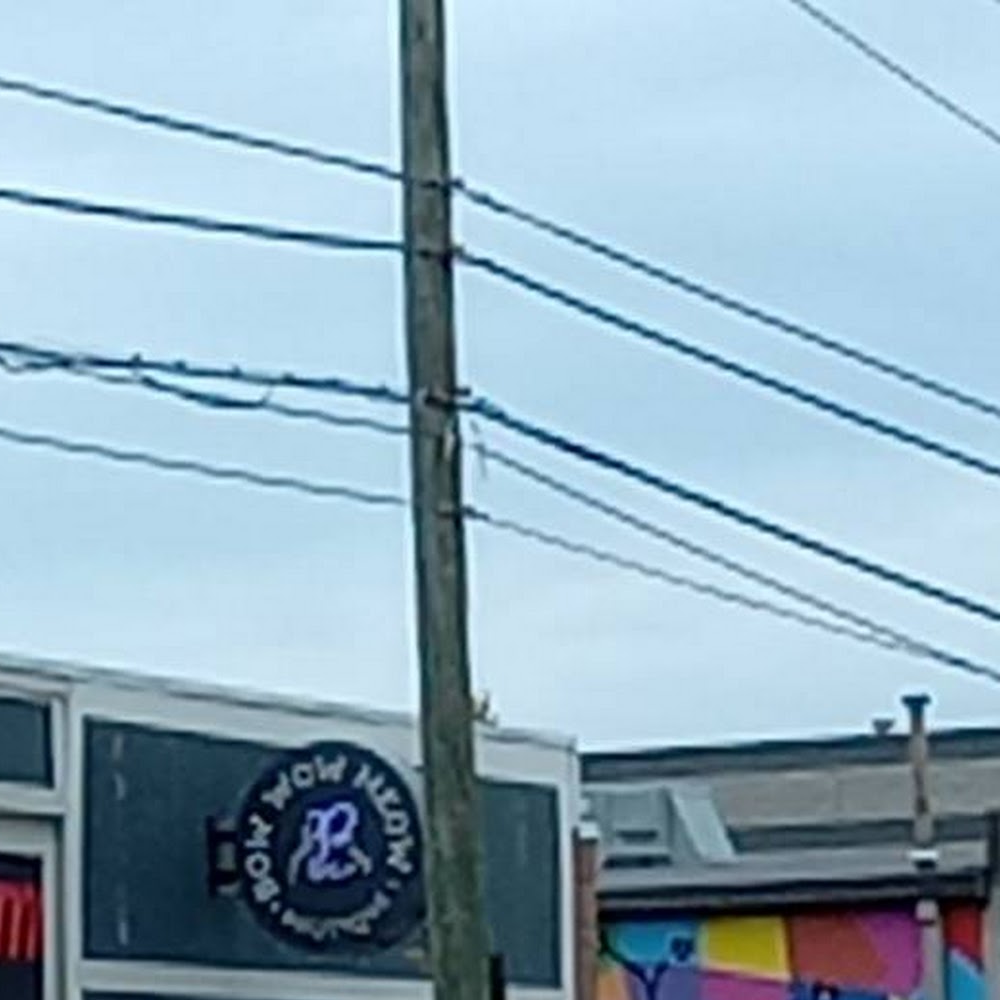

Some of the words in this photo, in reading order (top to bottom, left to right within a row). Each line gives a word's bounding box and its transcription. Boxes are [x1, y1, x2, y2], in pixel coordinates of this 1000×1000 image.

[260, 754, 349, 811] WOW
[352, 763, 415, 876] MEOW
[244, 813, 281, 902] BOW
